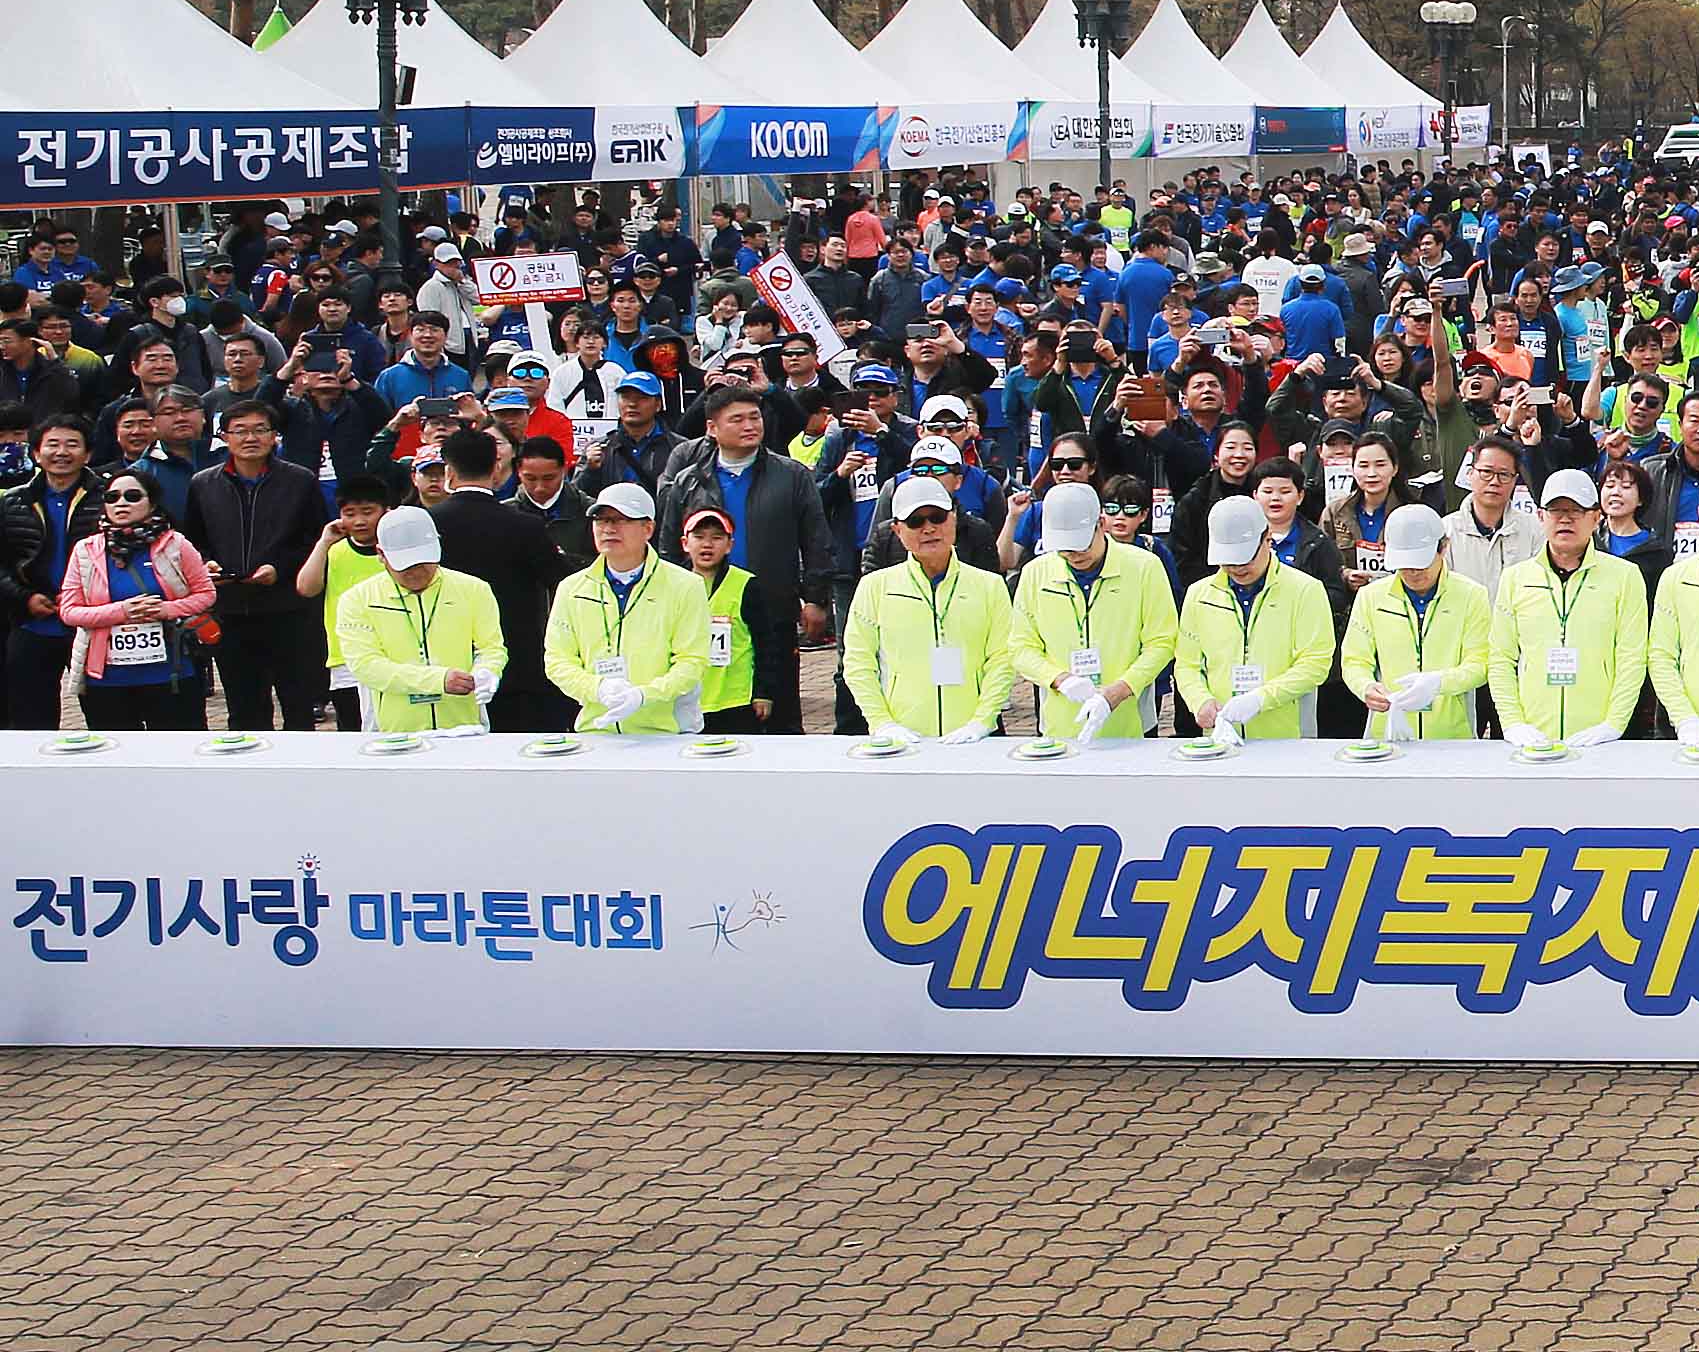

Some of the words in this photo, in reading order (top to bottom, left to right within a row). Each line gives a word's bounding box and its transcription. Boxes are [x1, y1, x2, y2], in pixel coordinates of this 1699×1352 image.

[498, 142, 593, 165] 엘비라이프(주)
[750, 120, 829, 159] KOCOM
[12, 874, 330, 967] 전기사랑
[348, 888, 665, 961] 마라톤대회
